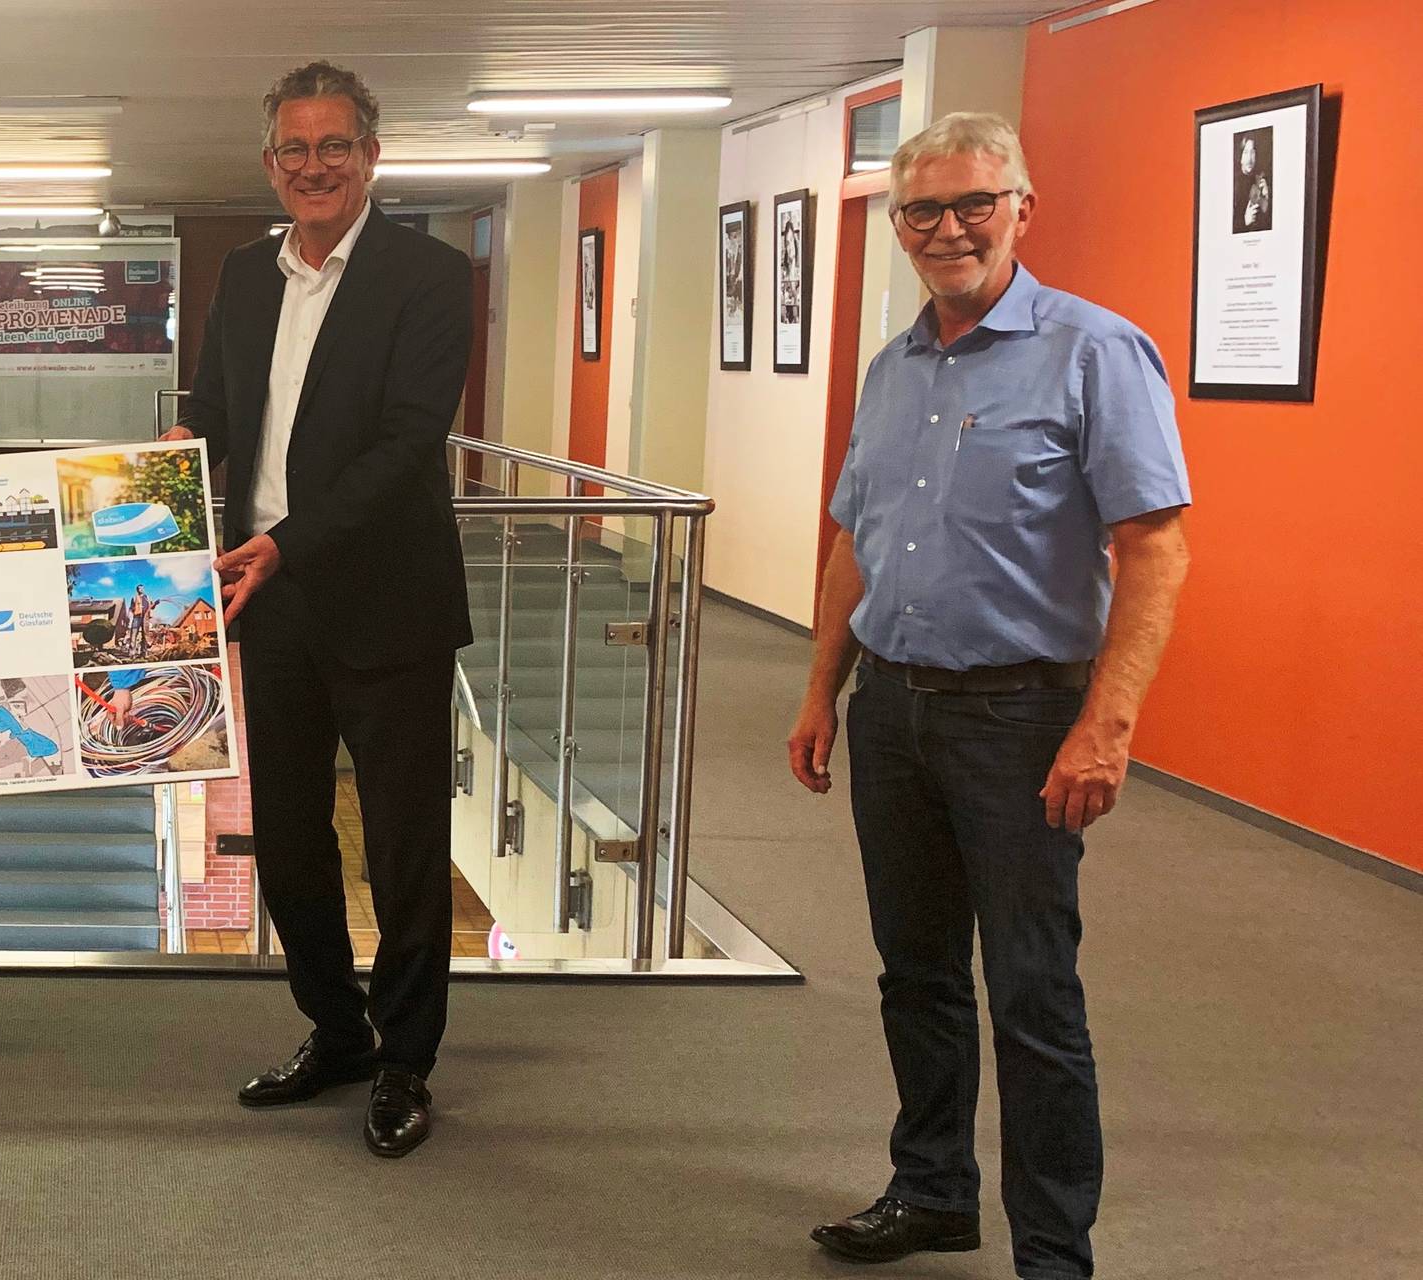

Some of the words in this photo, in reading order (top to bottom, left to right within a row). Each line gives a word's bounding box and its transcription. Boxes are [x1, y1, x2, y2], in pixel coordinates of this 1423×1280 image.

[52, 297, 92, 307] ONLINE
[28, 329, 54, 342] sind
[57, 327, 104, 343] gefragt!
